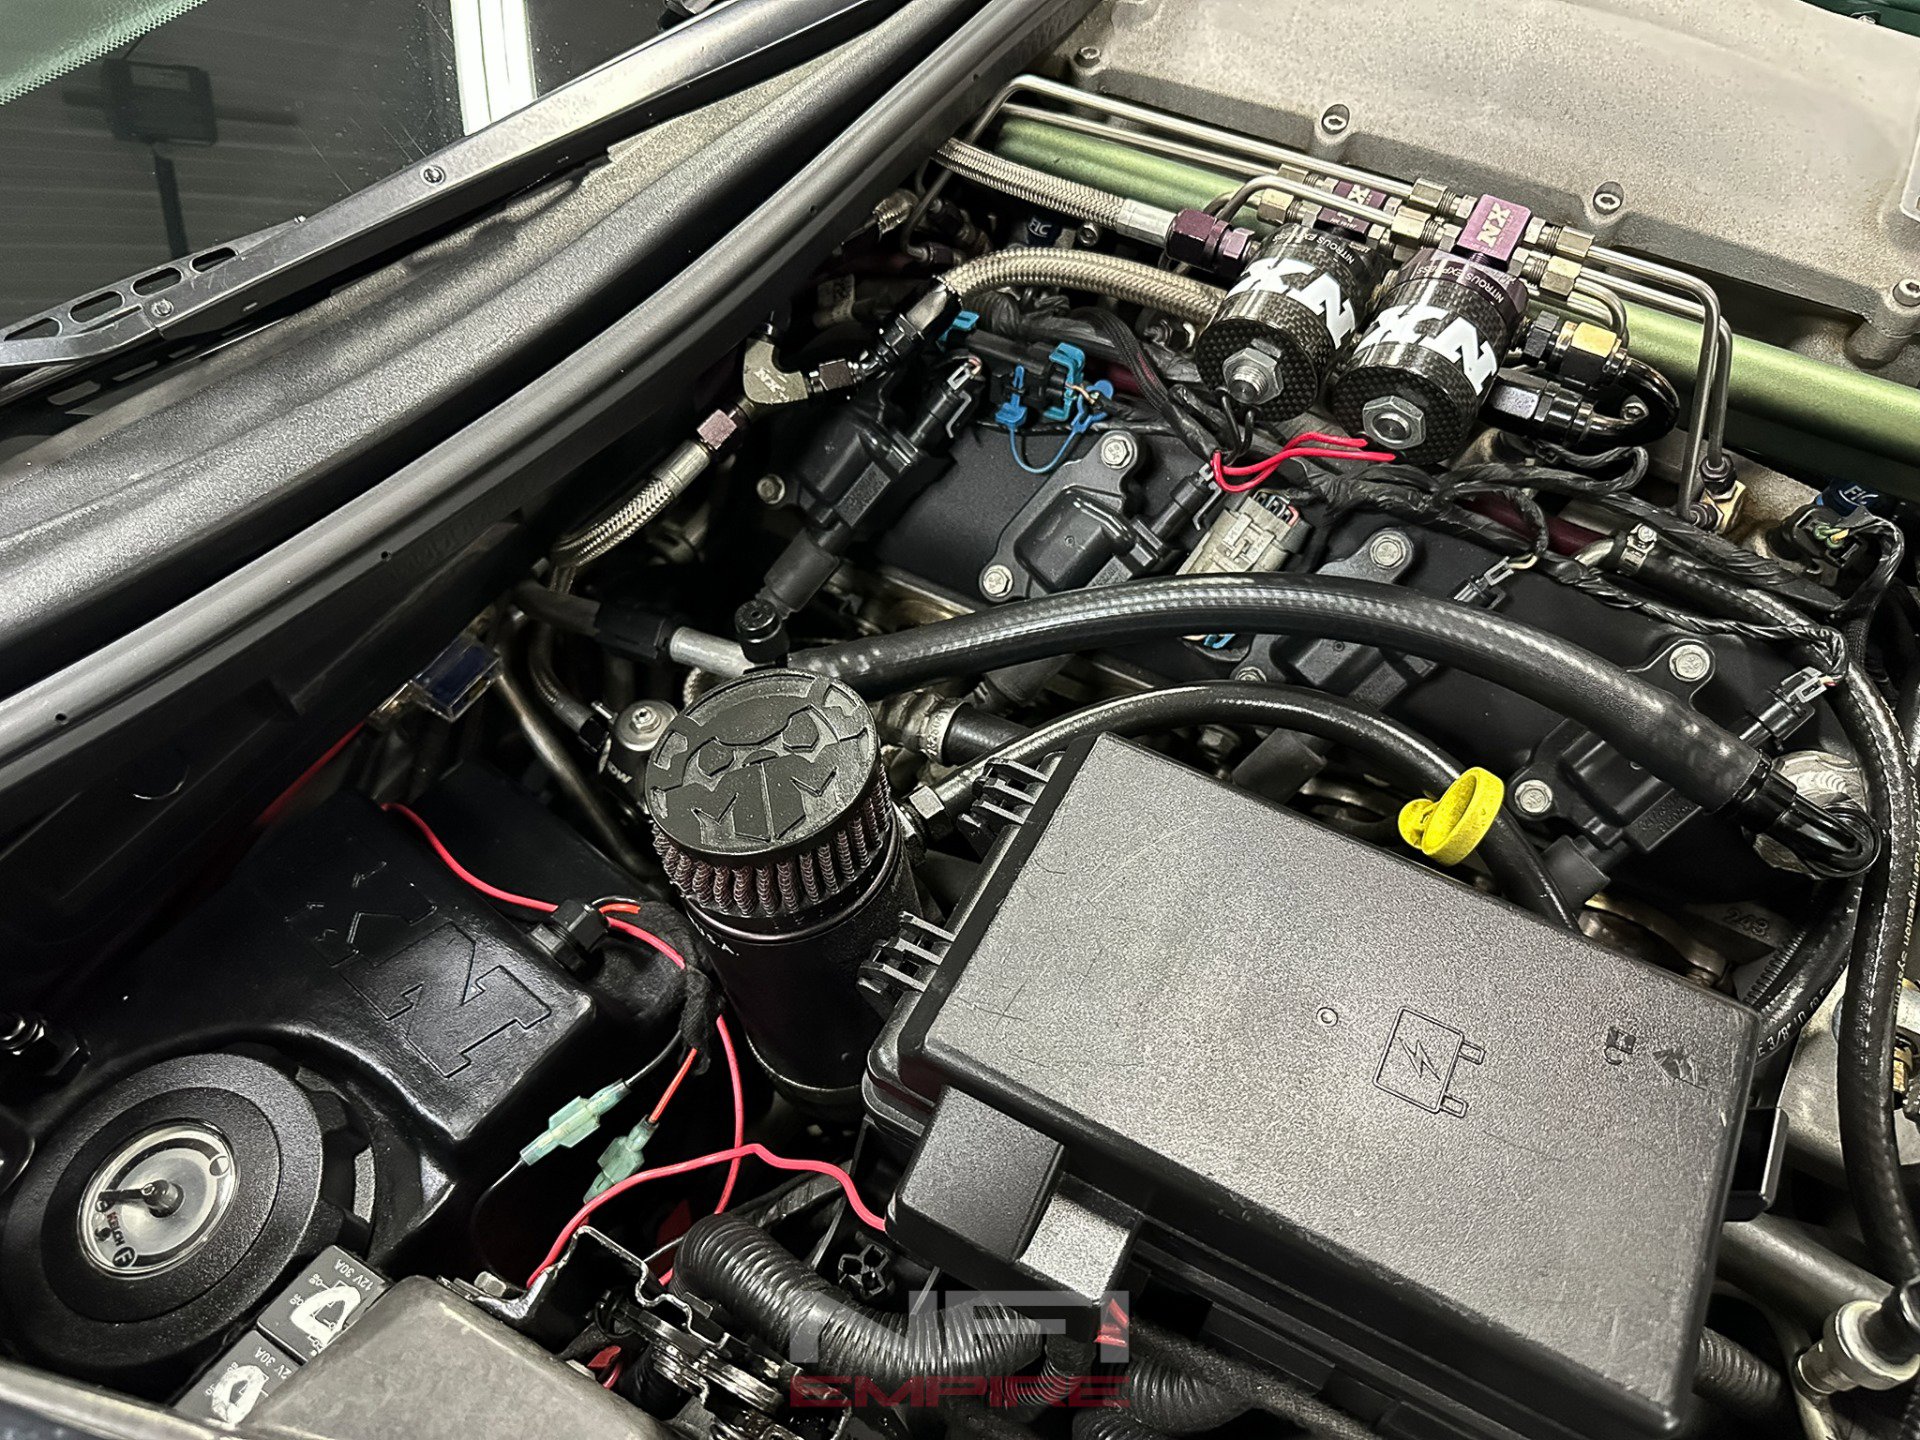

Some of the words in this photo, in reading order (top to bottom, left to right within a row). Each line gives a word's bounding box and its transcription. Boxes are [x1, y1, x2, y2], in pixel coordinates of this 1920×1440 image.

[1029, 217, 1052, 235] FIC
[1476, 202, 1511, 248] NX
[1316, 236, 1355, 265] NITROUS
[1416, 264, 1463, 279] EXPESS
[1464, 272, 1505, 303] NITROUS
[1226, 257, 1356, 349] NX
[1353, 304, 1498, 394] NX
[106, 1211, 126, 1247] KELCH
[114, 1250, 133, 1262] F
[333, 1257, 355, 1278] 30A
[353, 1274, 375, 1291] 12V
[253, 1347, 276, 1368] 30A
[275, 1364, 293, 1380] 2V
